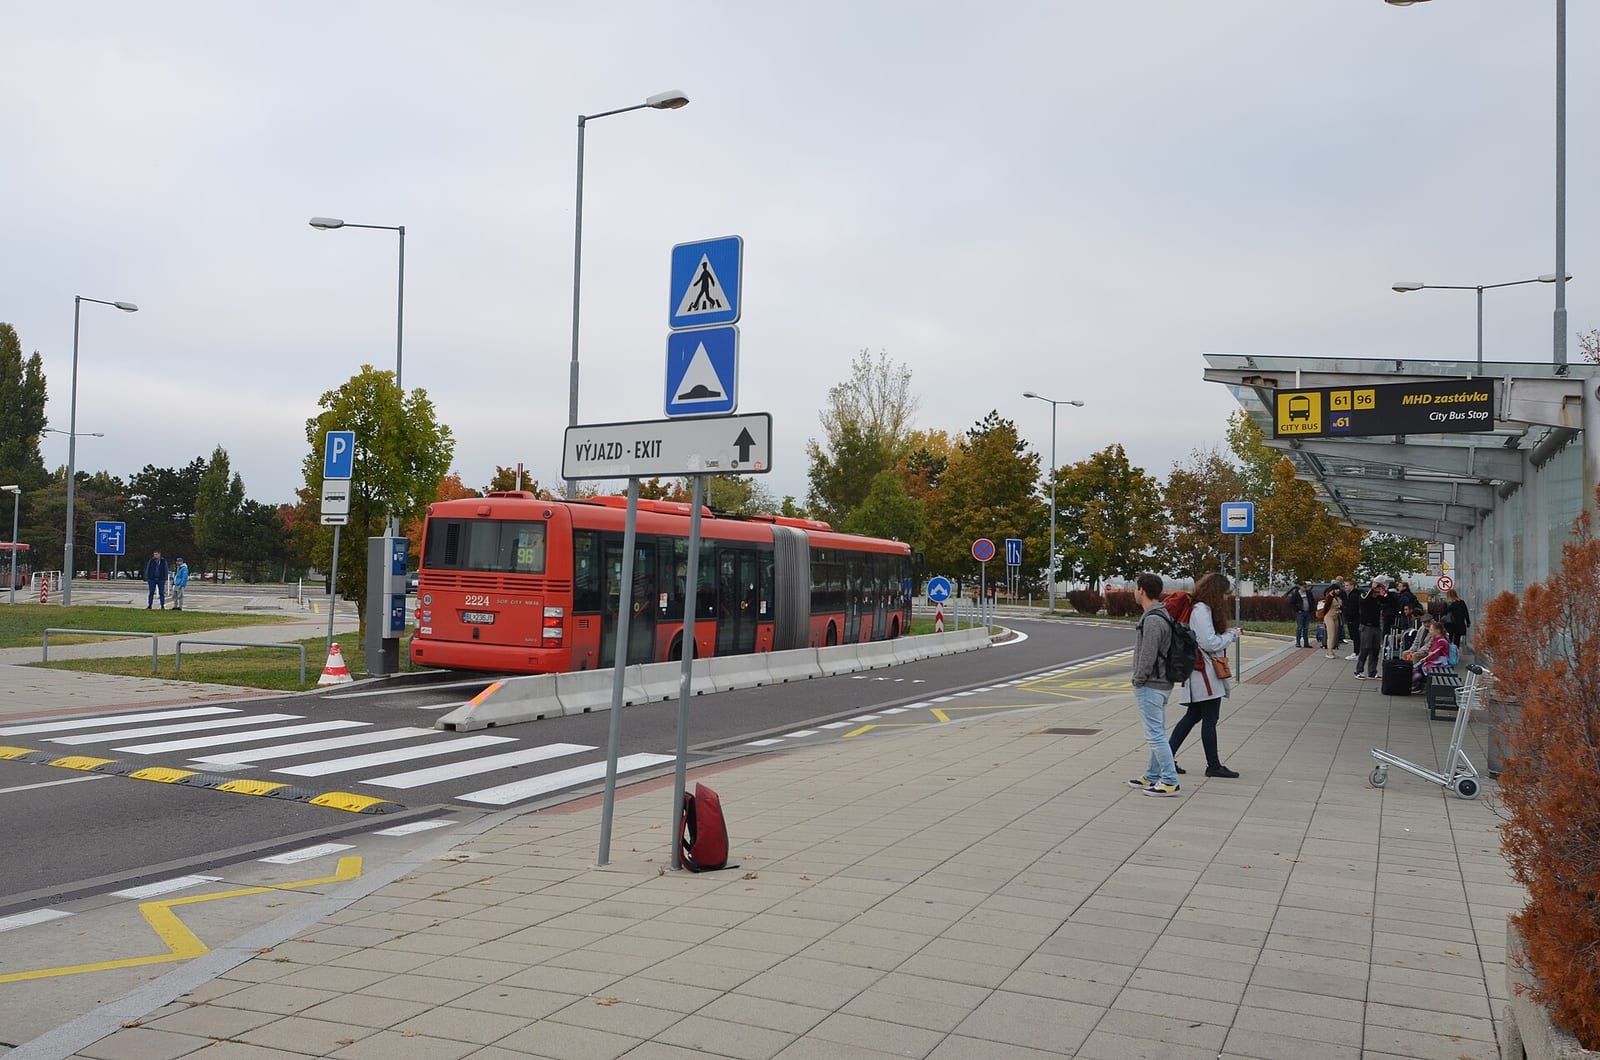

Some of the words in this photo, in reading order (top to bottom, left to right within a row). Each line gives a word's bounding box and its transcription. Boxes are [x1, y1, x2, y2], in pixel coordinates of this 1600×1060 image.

[1334, 396, 1348, 405] 61
[1356, 394, 1372, 404] 96
[1402, 393, 1432, 405] MHD
[1434, 391, 1489, 404] zastávka
[1429, 411, 1448, 422] City
[1449, 411, 1466, 420] Bus
[1467, 410, 1489, 420] Stop
[1301, 422, 1318, 430] BUS
[332, 437, 347, 463] P
[575, 439, 623, 462] VÝJAZD
[634, 440, 663, 459] EXIT
[517, 548, 534, 564] 96
[465, 595, 490, 606] 2224
